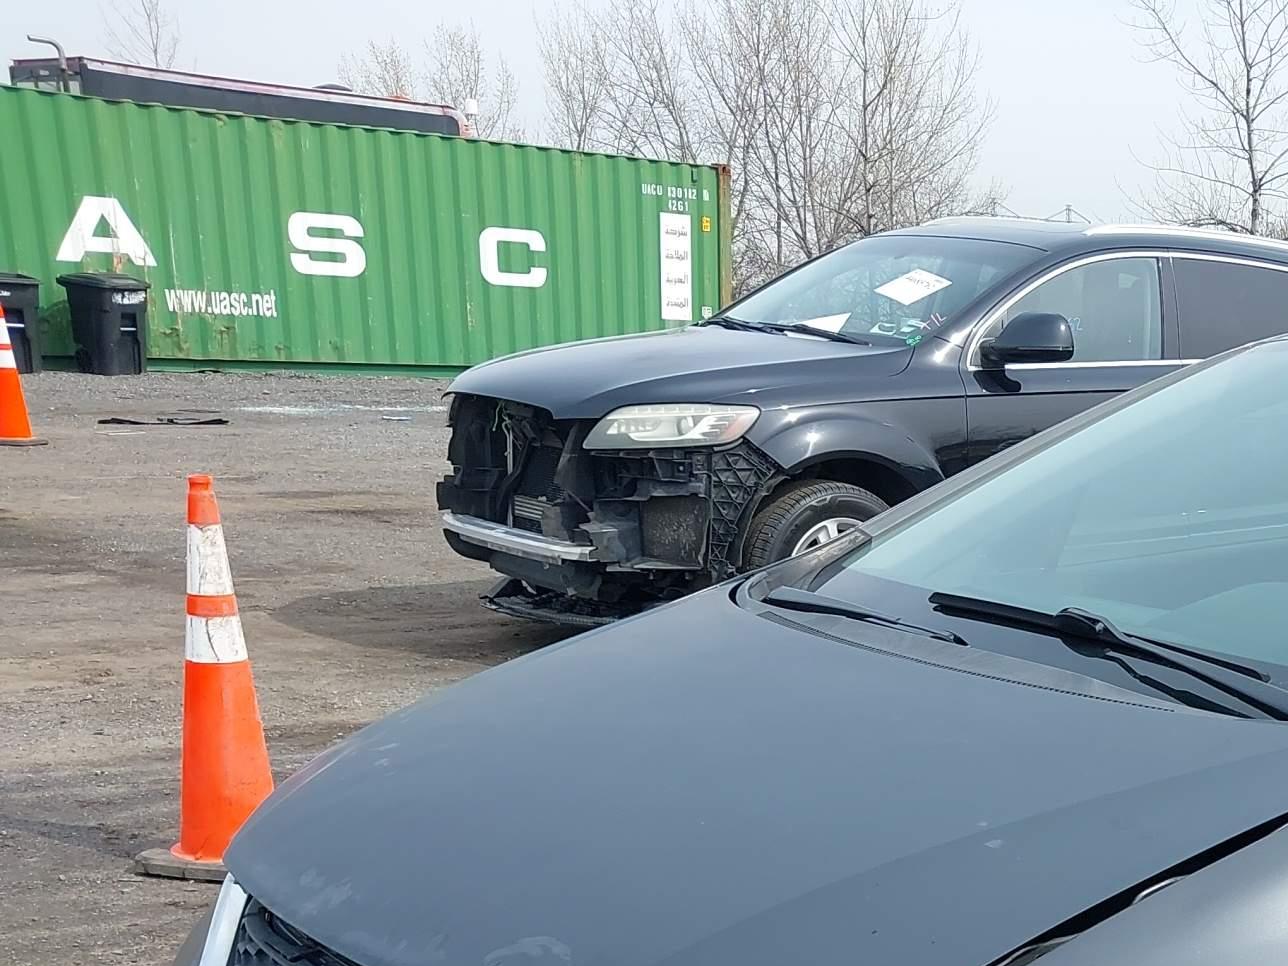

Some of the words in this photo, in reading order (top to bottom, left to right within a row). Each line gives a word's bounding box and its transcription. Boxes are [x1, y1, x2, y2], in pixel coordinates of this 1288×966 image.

[288, 212, 366, 277] S
[479, 227, 548, 288] C
[164, 288, 277, 318] www.uasc.net
